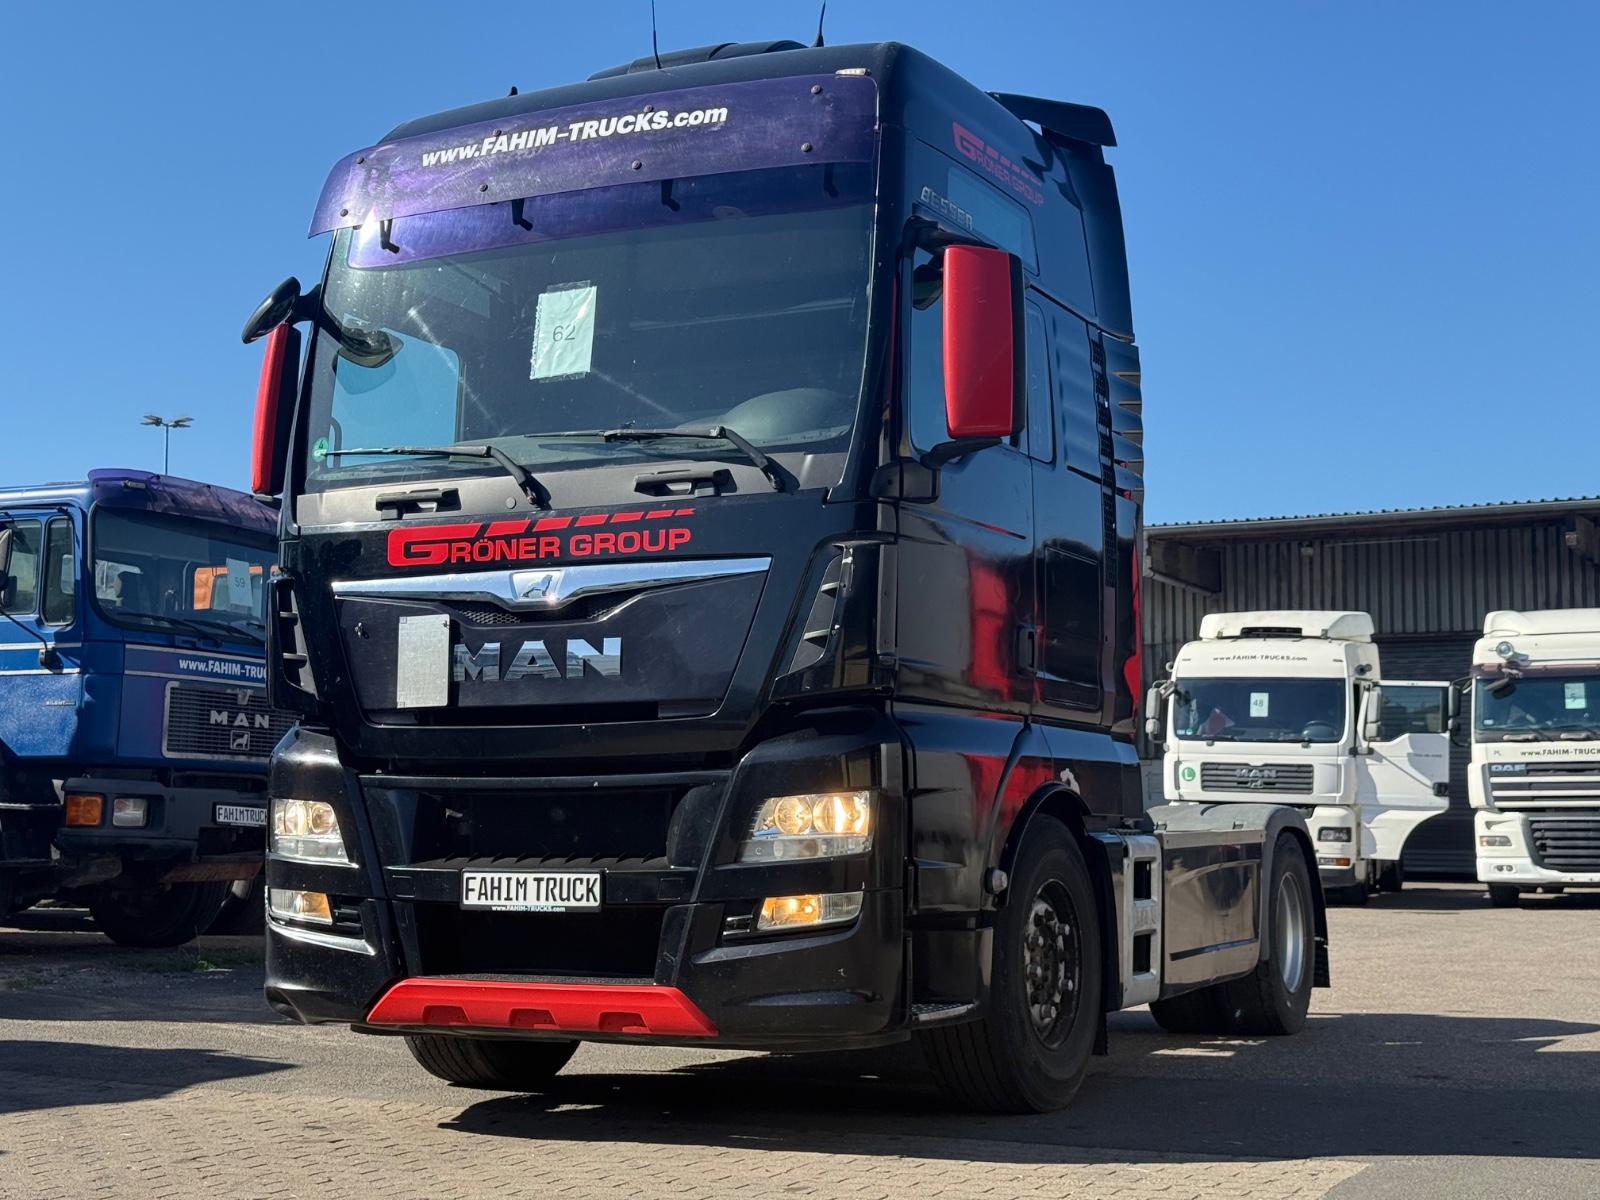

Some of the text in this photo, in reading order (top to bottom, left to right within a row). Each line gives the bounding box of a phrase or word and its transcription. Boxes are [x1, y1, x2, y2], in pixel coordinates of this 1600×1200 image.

[422, 107, 728, 168] www.FAHIM-TRUCKS.com
[552, 324, 576, 342] 62
[387, 522, 692, 568] GRÖNER GROUP
[234, 576, 246, 588] 59
[453, 636, 623, 682] MAN
[1252, 699, 1264, 708] 48
[209, 710, 270, 729] MAN
[1235, 769, 1278, 778] MAN
[1491, 764, 1526, 772] DAF
[465, 877, 598, 902] FAHIM TRUCK
